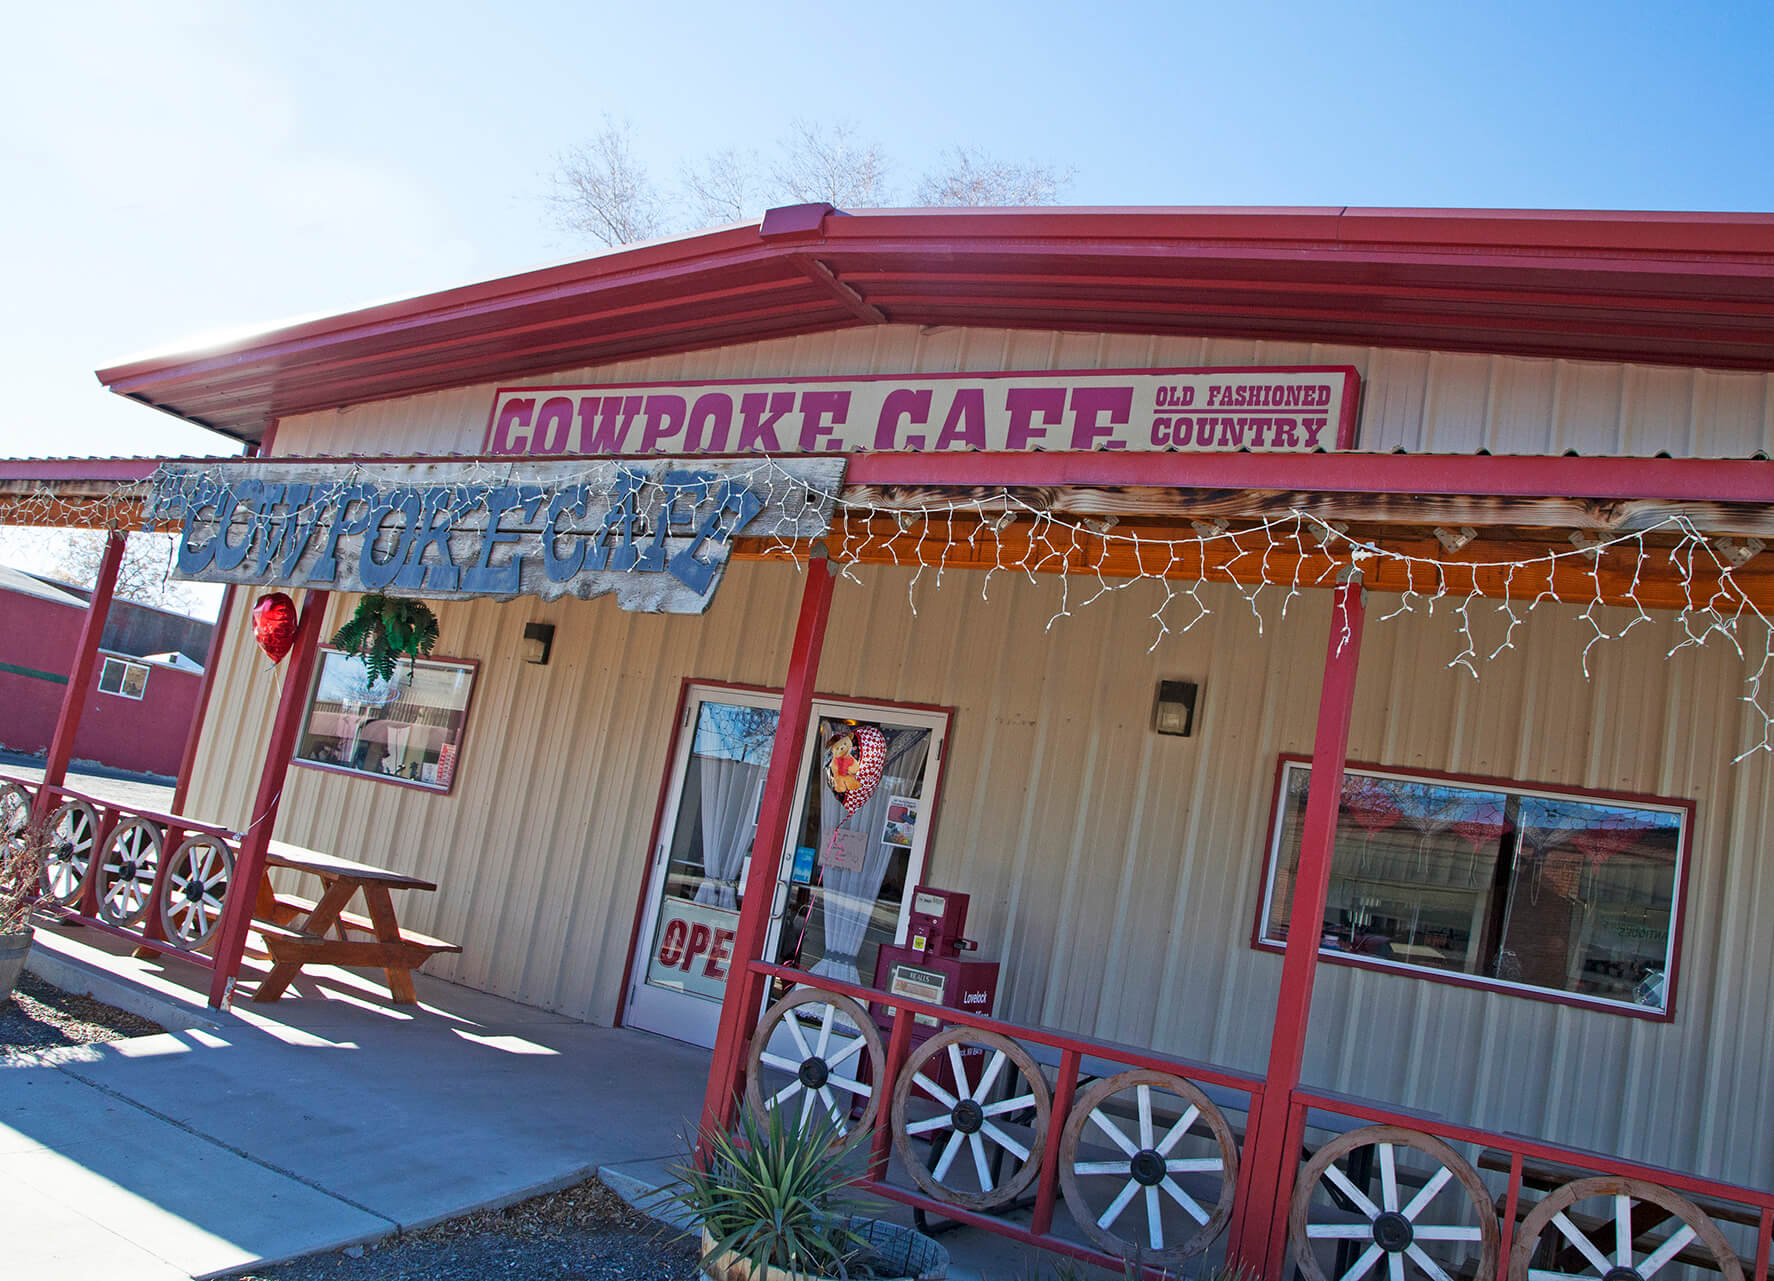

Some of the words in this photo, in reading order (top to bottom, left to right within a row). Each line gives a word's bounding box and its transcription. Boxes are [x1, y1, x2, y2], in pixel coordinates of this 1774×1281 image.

[492, 391, 852, 453] COWPOKE
[874, 386, 1134, 449] CAFE
[1155, 385, 1195, 407] OLD
[1206, 384, 1331, 407] FASHIONED
[1150, 416, 1328, 448] COUNTRY
[542, 467, 766, 597] CAFE
[658, 917, 737, 984] OPE
